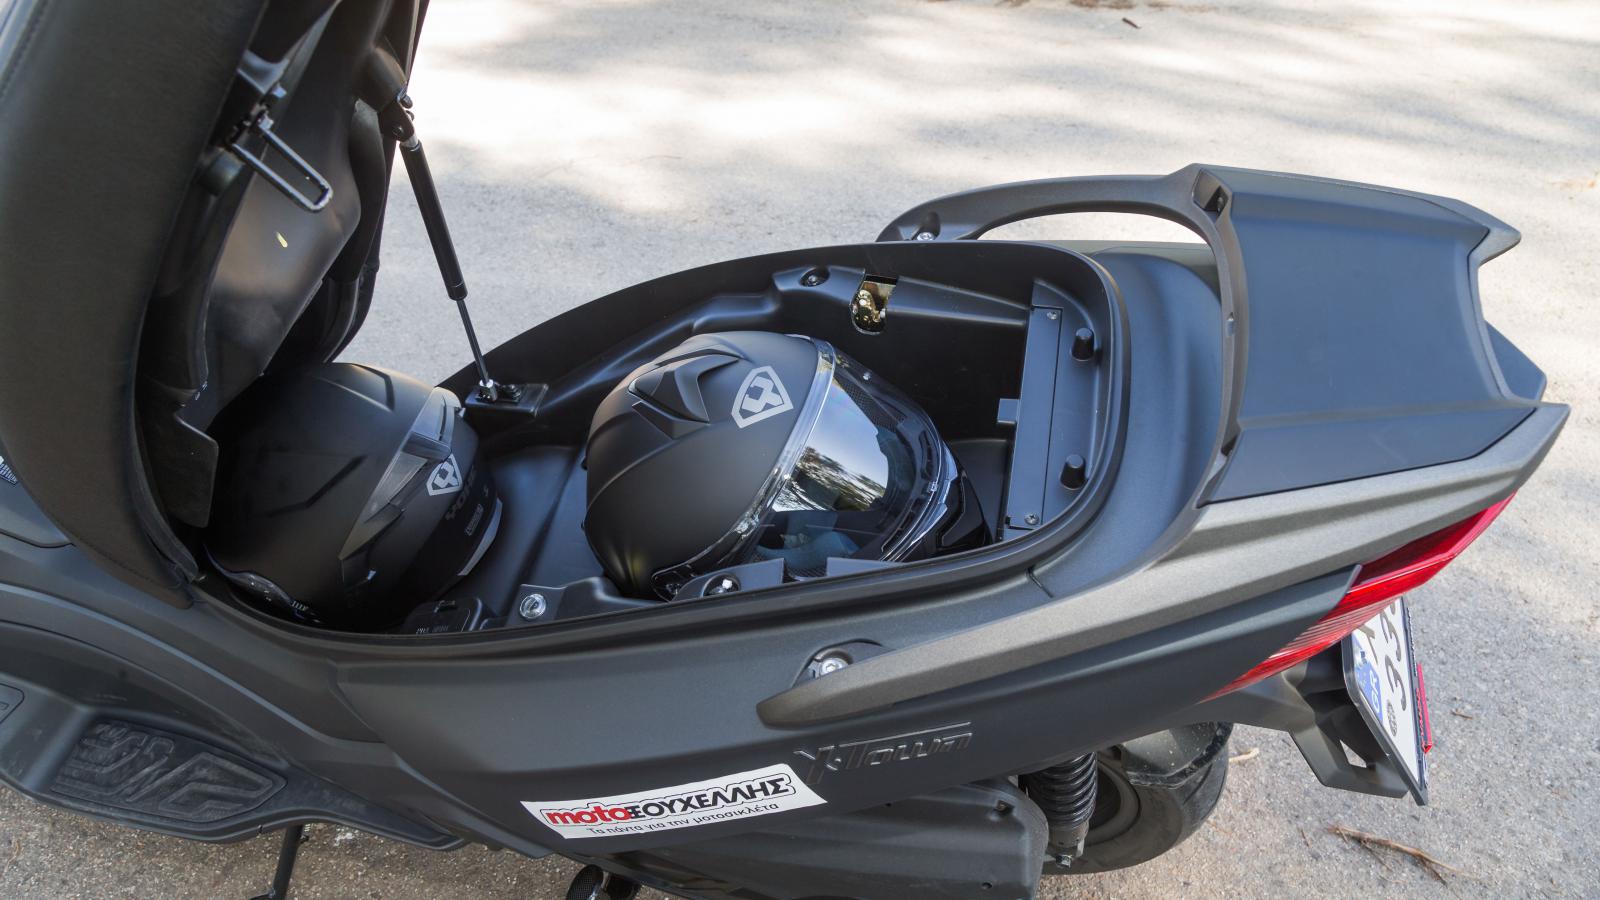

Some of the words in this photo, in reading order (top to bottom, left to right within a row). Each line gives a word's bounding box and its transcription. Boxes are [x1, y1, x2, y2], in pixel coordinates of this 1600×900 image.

[1380, 601, 1407, 711] 33
[1369, 669, 1380, 714] GR
[644, 822, 664, 833] για
[667, 819, 690, 827] την
[692, 803, 780, 824] μοτοσικλέτα
